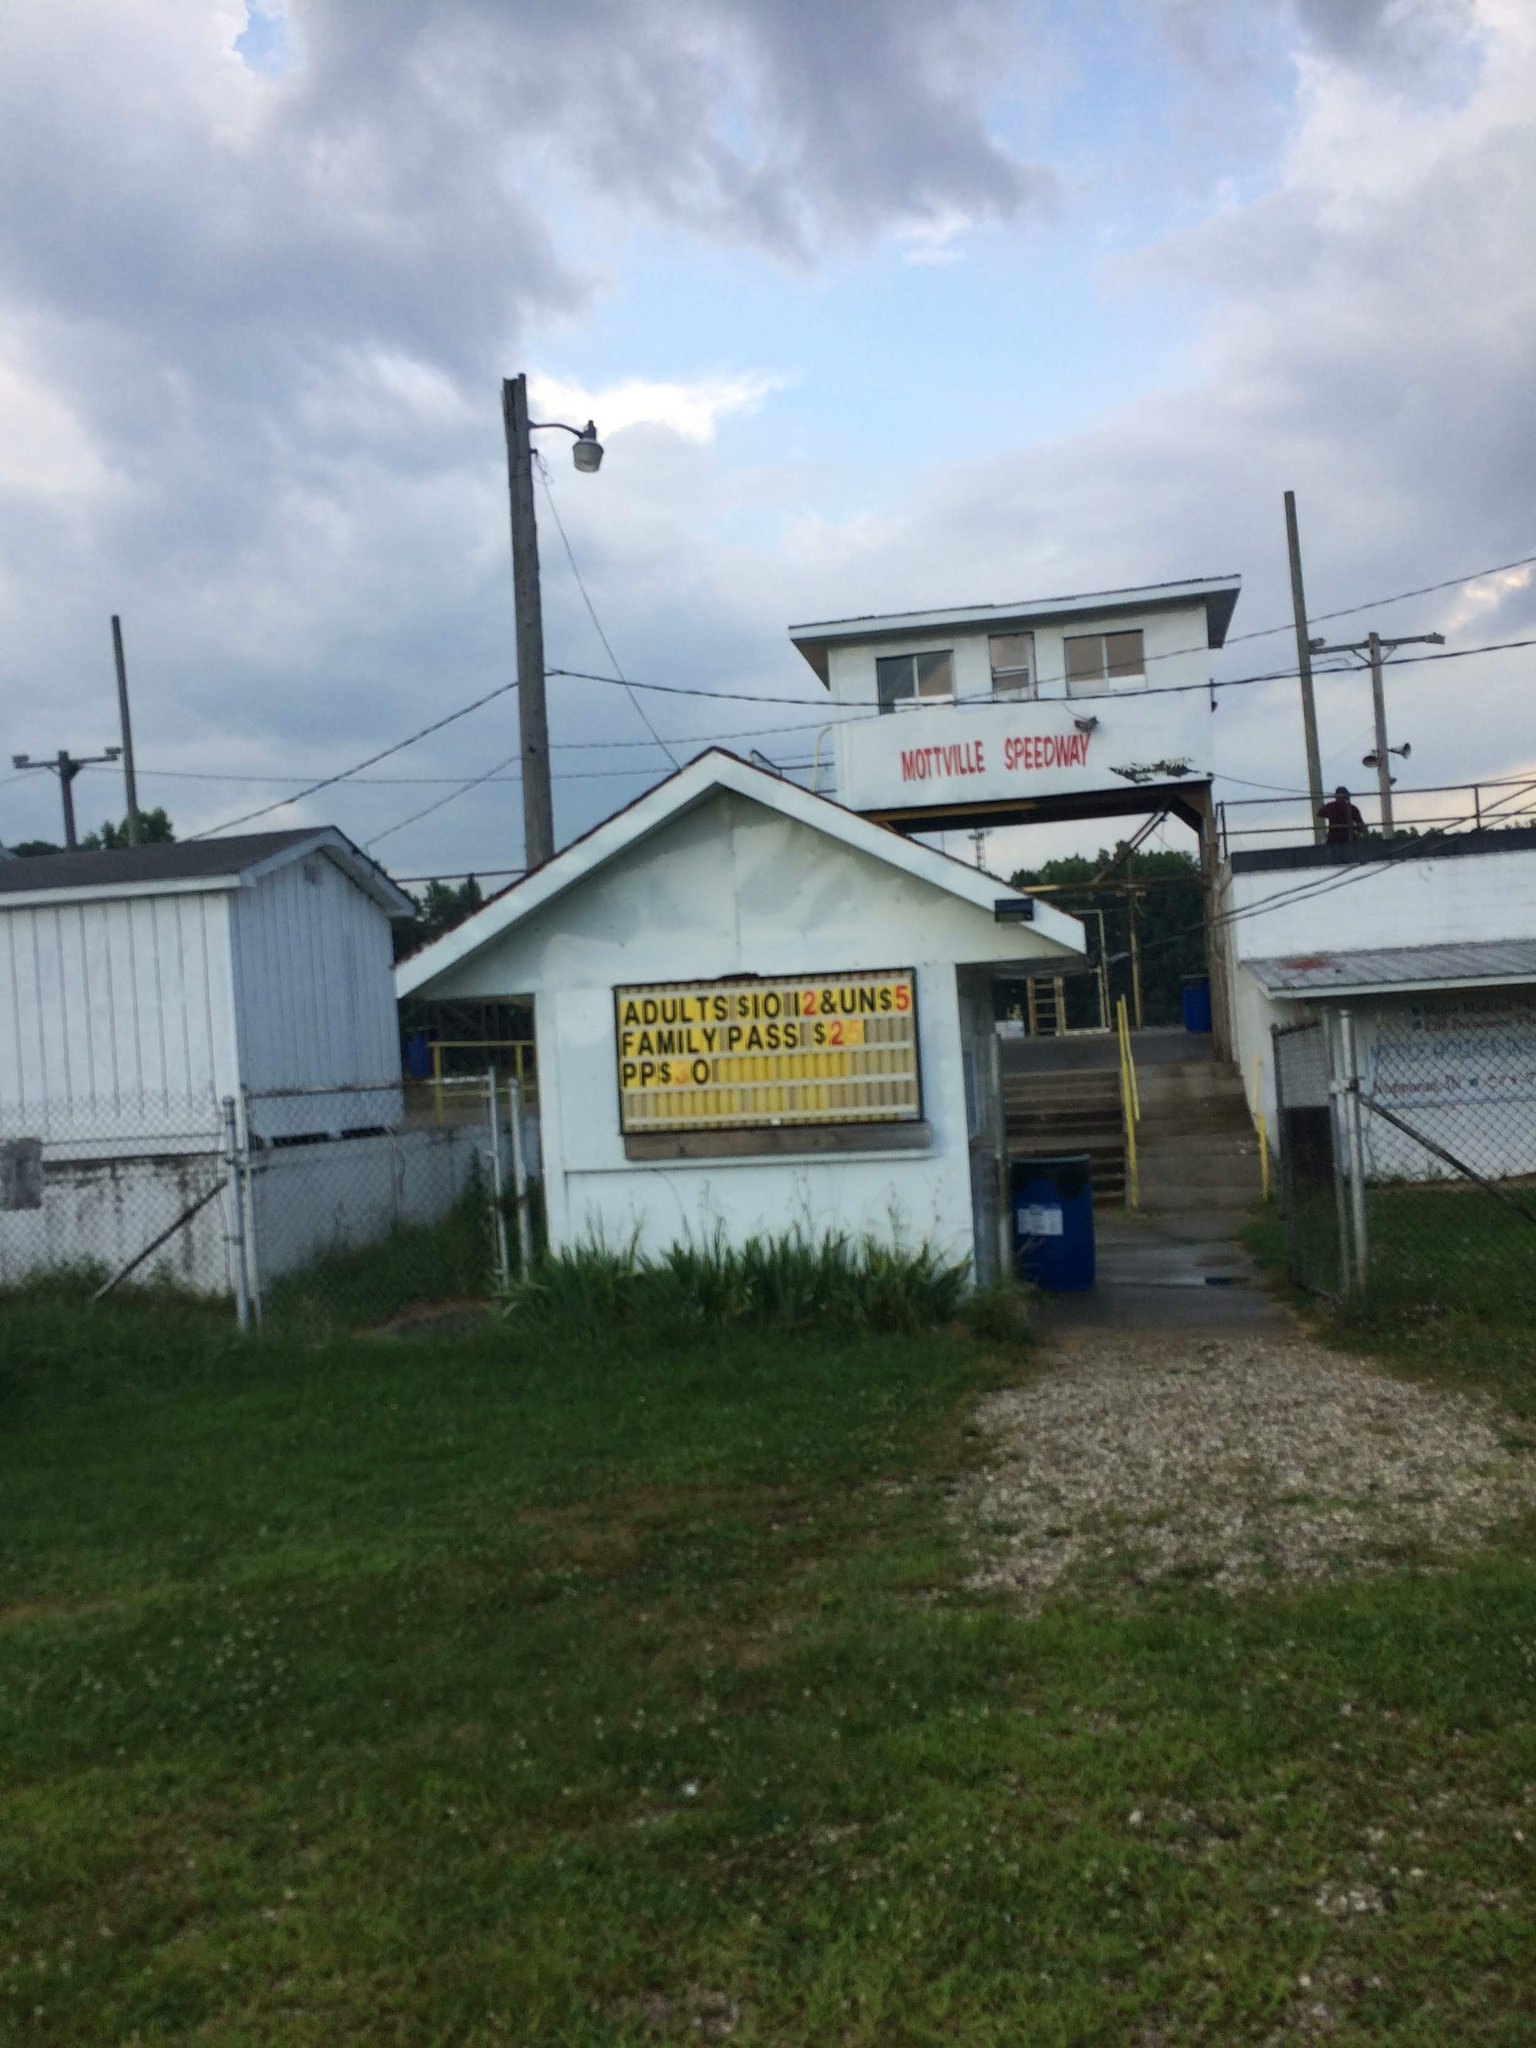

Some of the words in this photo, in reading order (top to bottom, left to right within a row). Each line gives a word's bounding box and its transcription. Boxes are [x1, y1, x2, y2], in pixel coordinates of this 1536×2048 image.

[901, 740, 985, 782] MOTTVILLE
[1004, 734, 1091, 771] SPEEDWAY
[624, 995, 729, 1026] ADULTS
[738, 992, 782, 1018] $10
[622, 1027, 720, 1057] FAMILY
[728, 1023, 799, 1051] PASS
